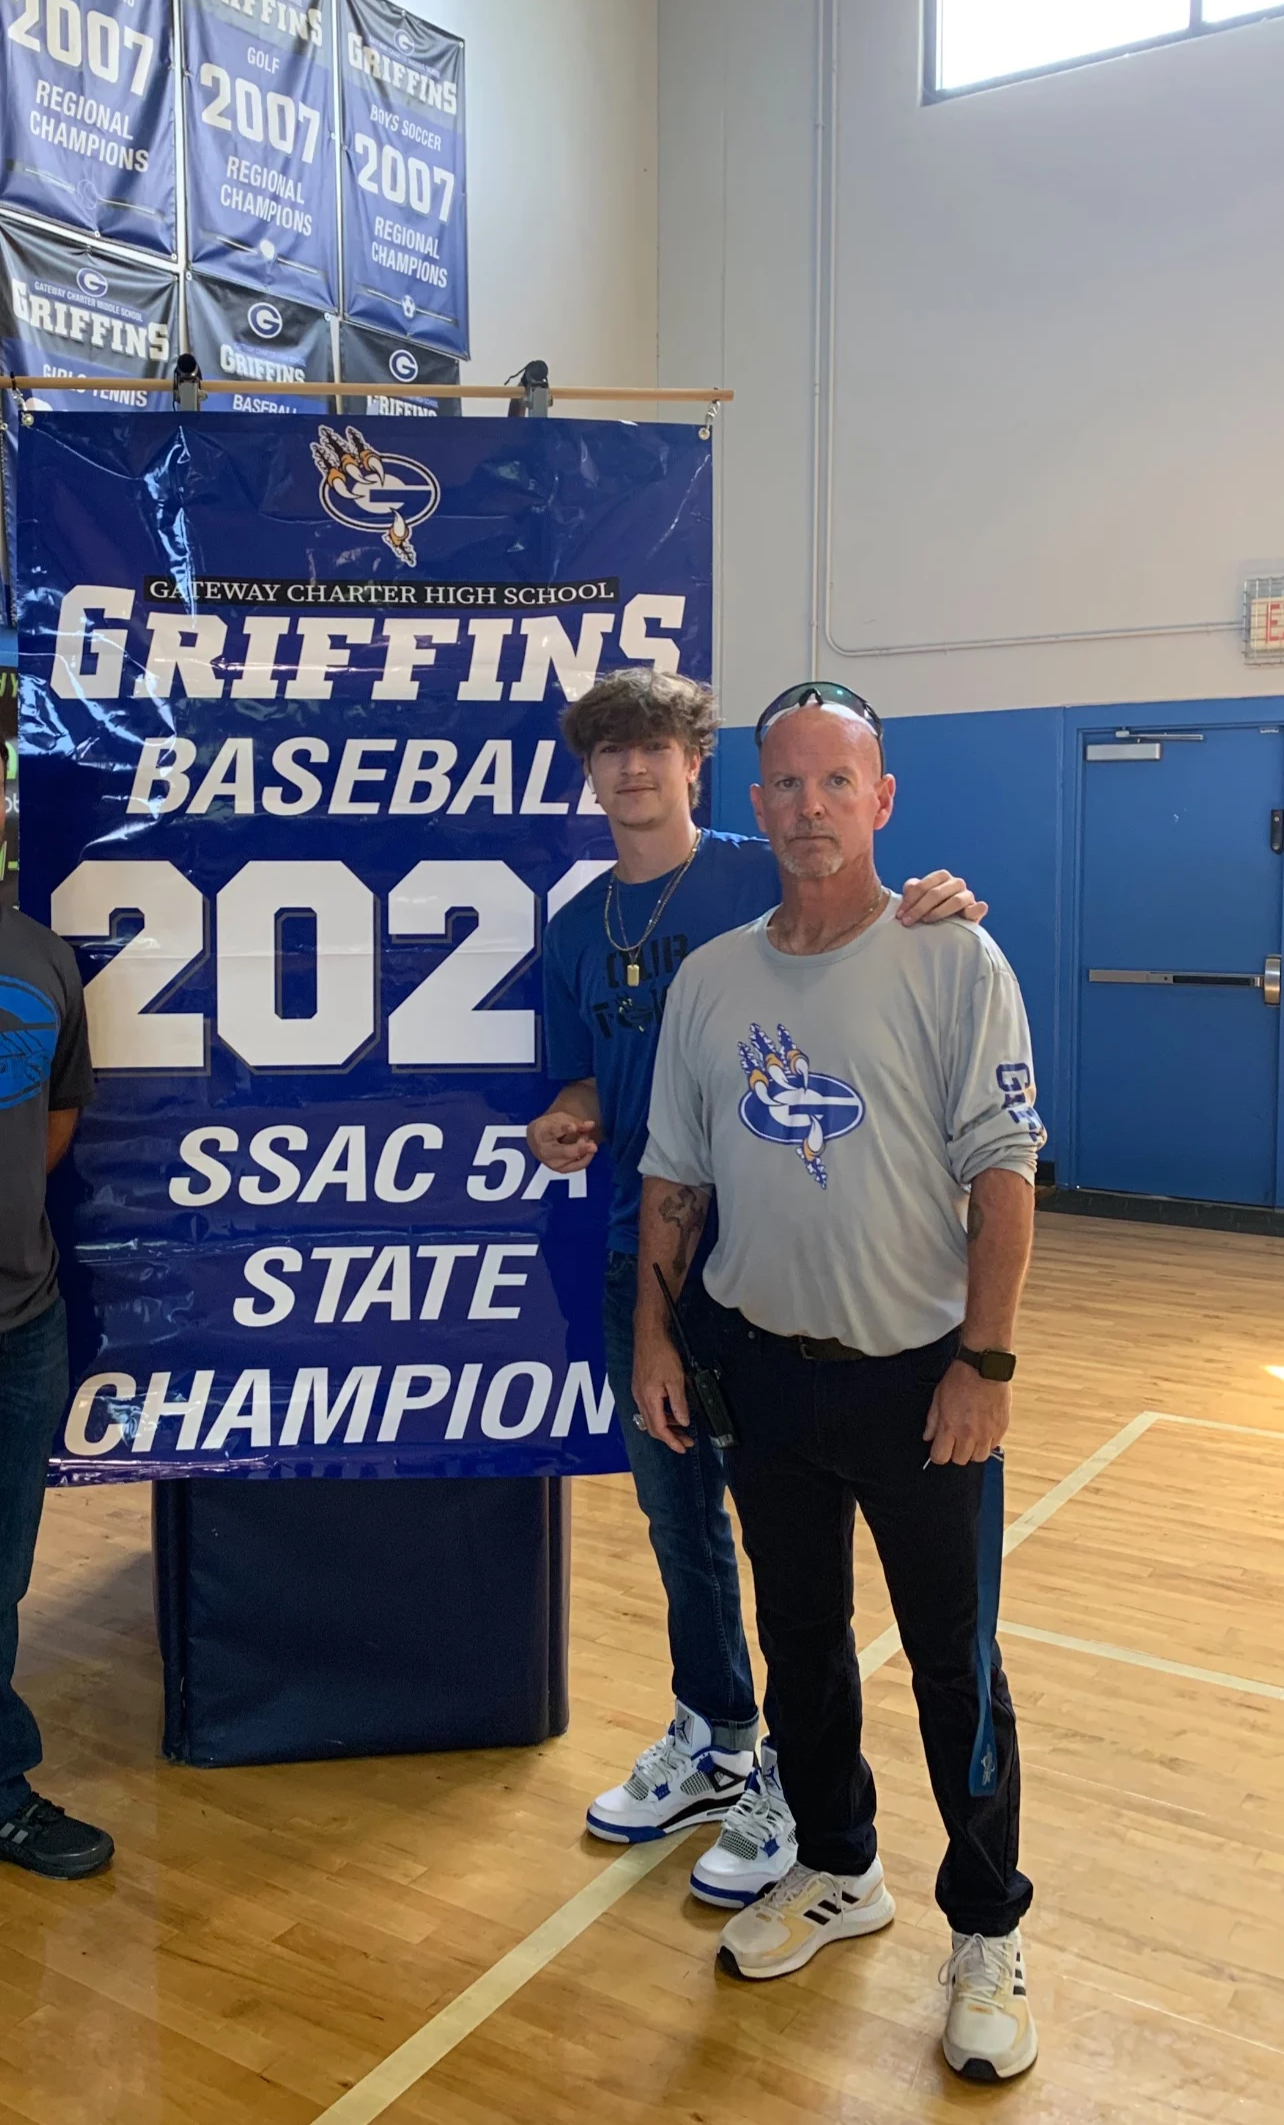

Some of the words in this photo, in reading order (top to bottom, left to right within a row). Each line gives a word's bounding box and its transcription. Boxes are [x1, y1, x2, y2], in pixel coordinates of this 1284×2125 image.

[7, 0, 154, 97] 2007
[247, 46, 280, 75] GOLF
[347, 31, 457, 115] GRIFFINS
[29, 110, 150, 173] CHAMPIONS
[35, 79, 134, 141] REGIONAL
[200, 62, 321, 164] 2007
[370, 104, 400, 132] BOYS
[401, 119, 442, 152] SOCCER
[227, 155, 304, 204] REGIONAL
[355, 132, 455, 223] 2007
[220, 184, 313, 237] CHAMPIONS
[374, 215, 440, 260] REGIONAL
[371, 241, 448, 289] CHAMPIONS
[12, 278, 170, 361] GRIFFINS
[34, 280, 67, 298] GATEWAY
[67, 290, 96, 307] CHARTER
[120, 306, 144, 323] SCHOOL
[220, 343, 306, 383] GRIFFINS
[149, 580, 281, 602] GATEWAY
[287, 584, 417, 604] CHARTER
[424, 586, 497, 605] HIGH
[503, 581, 615, 605] SCHOOL
[50, 585, 687, 702] GRIFFINS
[50, 860, 619, 1068] 202
[168, 1123, 443, 1206] SSAC
[232, 1244, 539, 1328] STATE
[63, 1360, 617, 1455] CHAMPION
